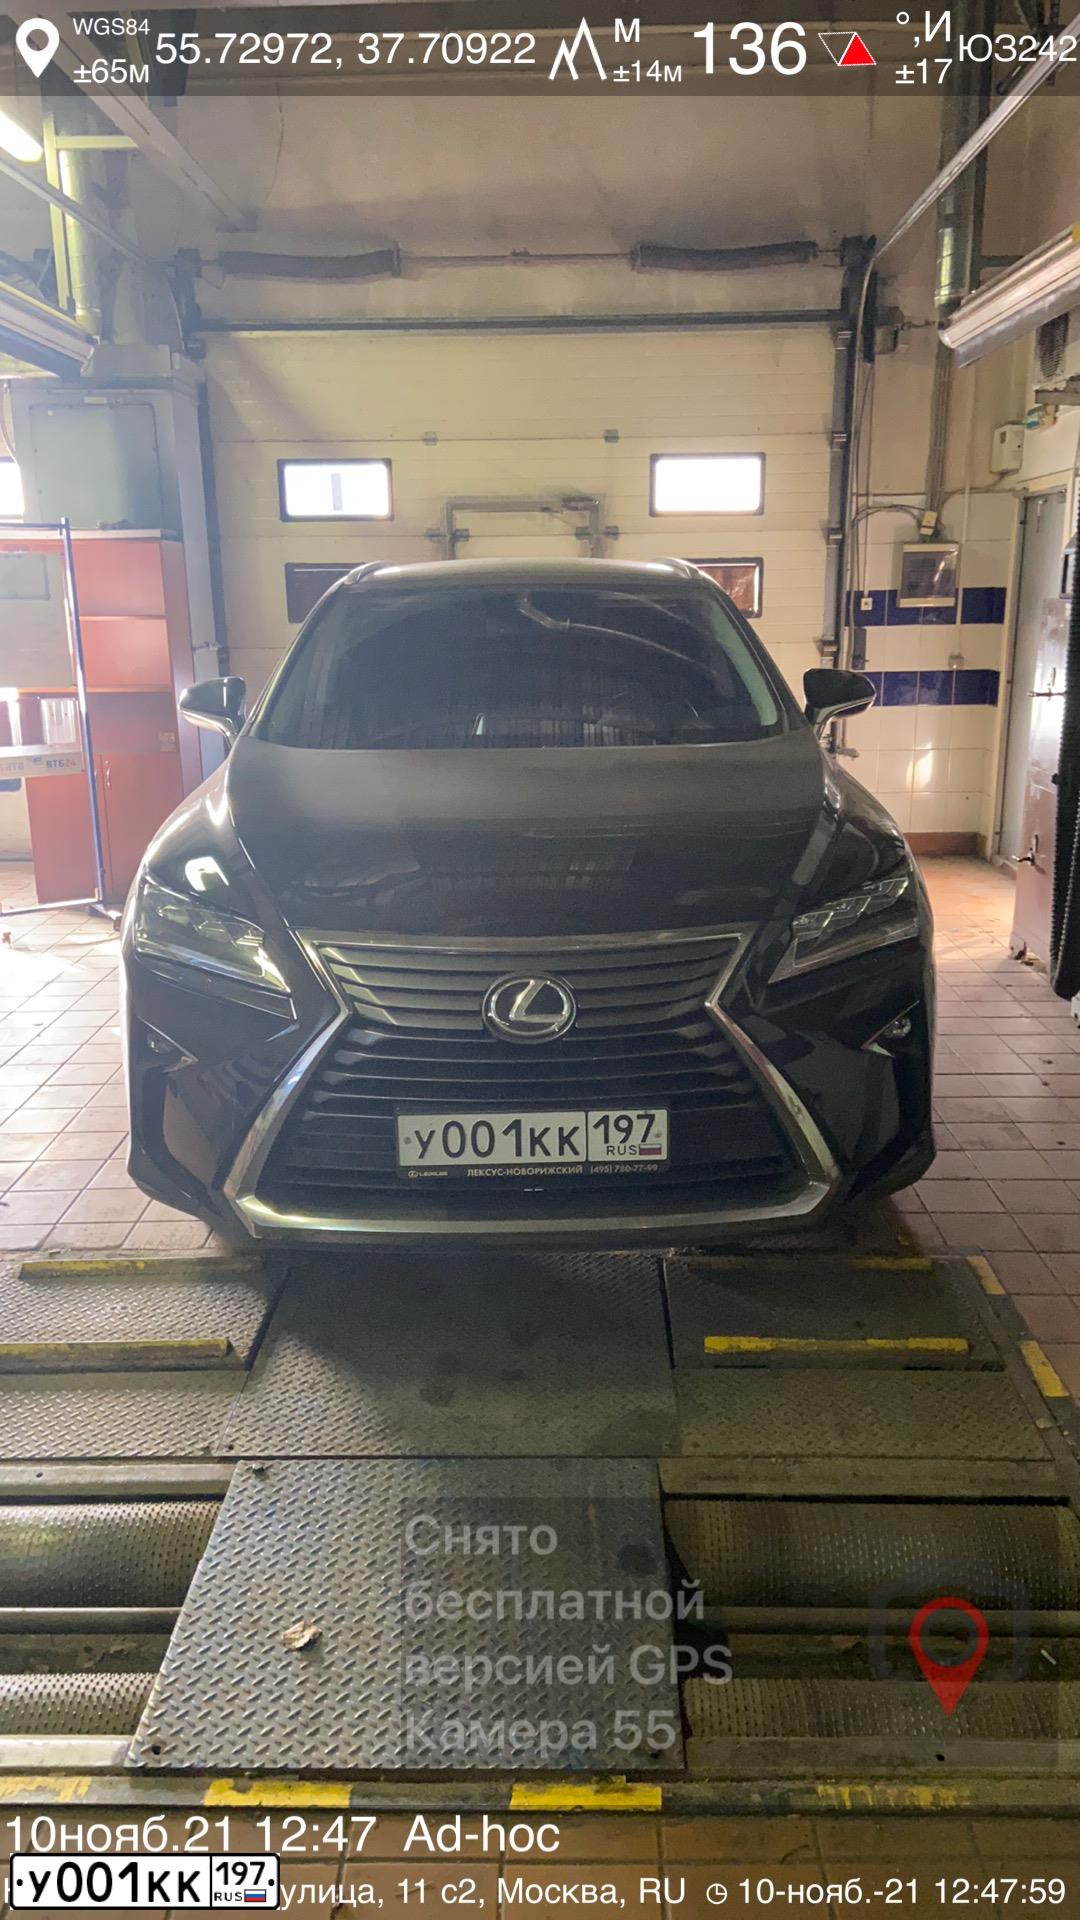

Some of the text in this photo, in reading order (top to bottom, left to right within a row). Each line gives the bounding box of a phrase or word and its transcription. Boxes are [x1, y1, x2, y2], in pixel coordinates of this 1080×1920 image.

[414, 1114, 656, 1160] У001КК 197
[606, 1144, 638, 1156] RUS
[466, 1165, 584, 1178] ЛЕКСУС-НОВОРИЖСКИЙ
